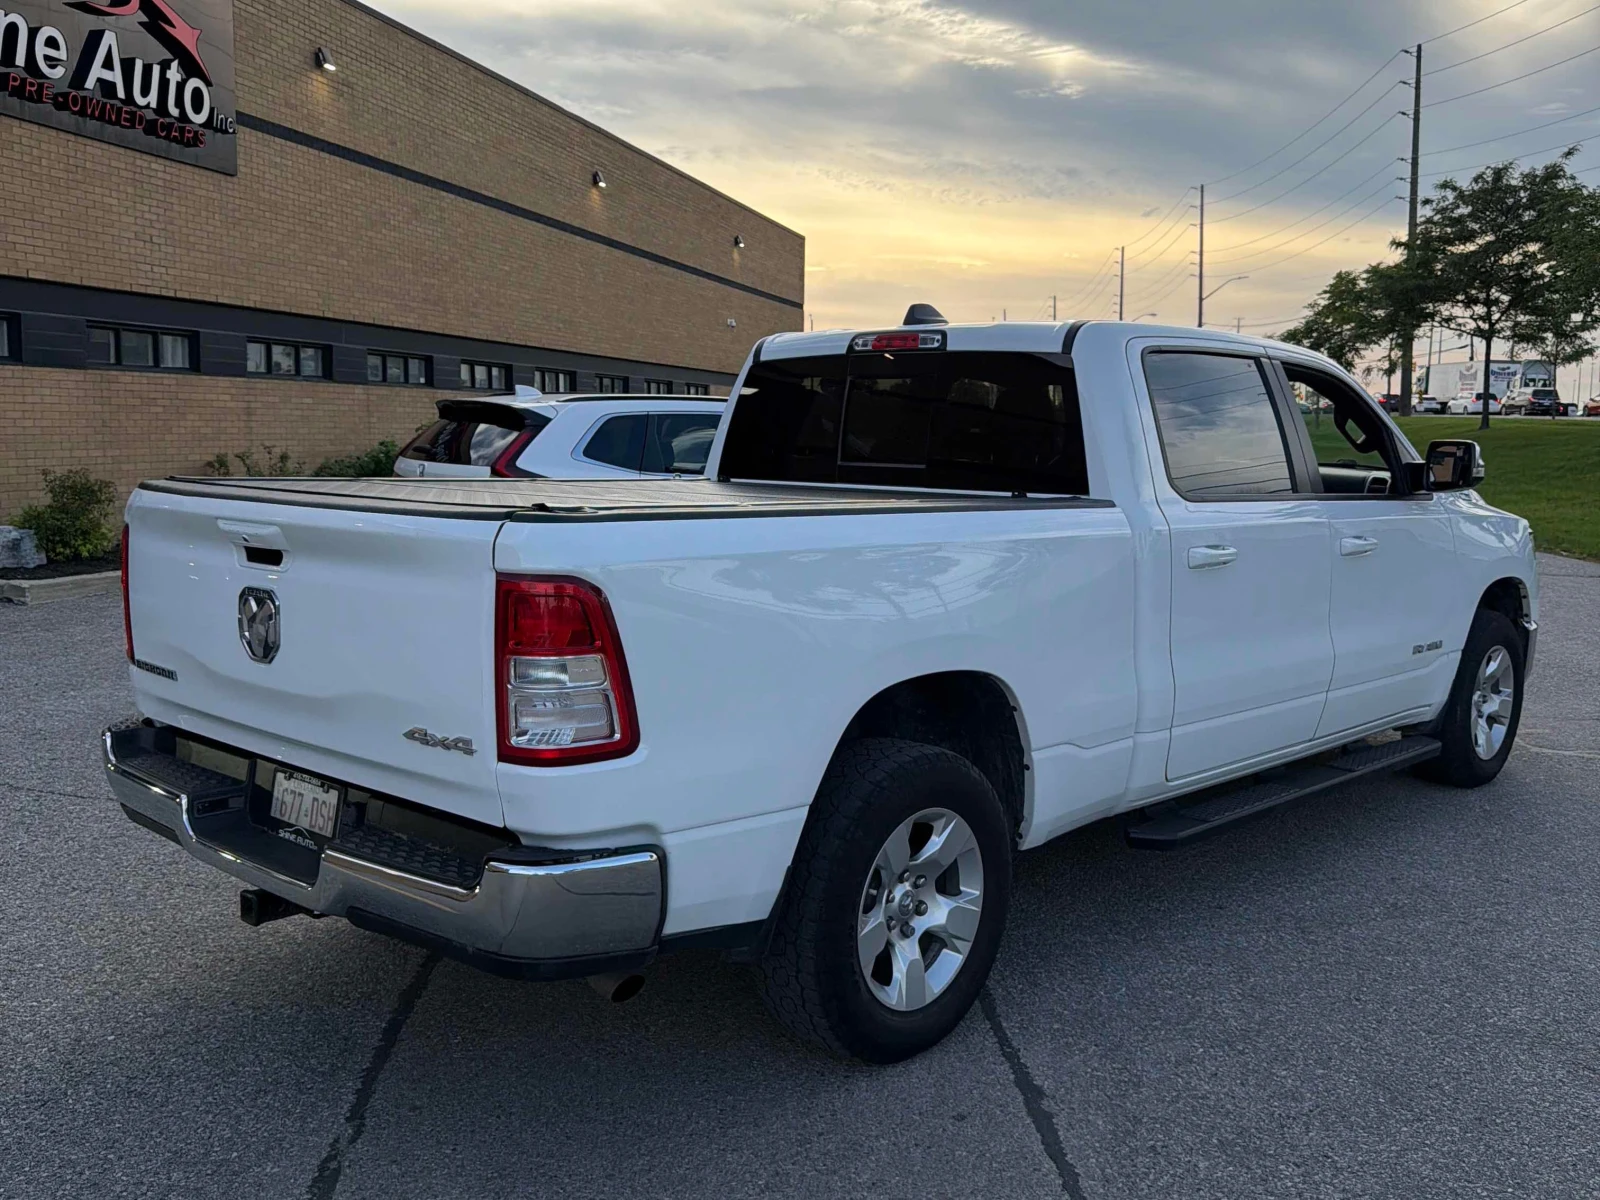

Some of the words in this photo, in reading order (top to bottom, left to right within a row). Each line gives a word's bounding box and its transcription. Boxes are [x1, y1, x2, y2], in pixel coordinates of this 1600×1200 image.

[84, 28, 211, 124] Auto
[8, 72, 146, 130] PRE-OWNED
[157, 118, 207, 148] CARS
[278, 829, 296, 842] SHINE
[296, 836, 315, 848] AUTO
[280, 787, 304, 824] 677
[309, 796, 336, 837] DSH
